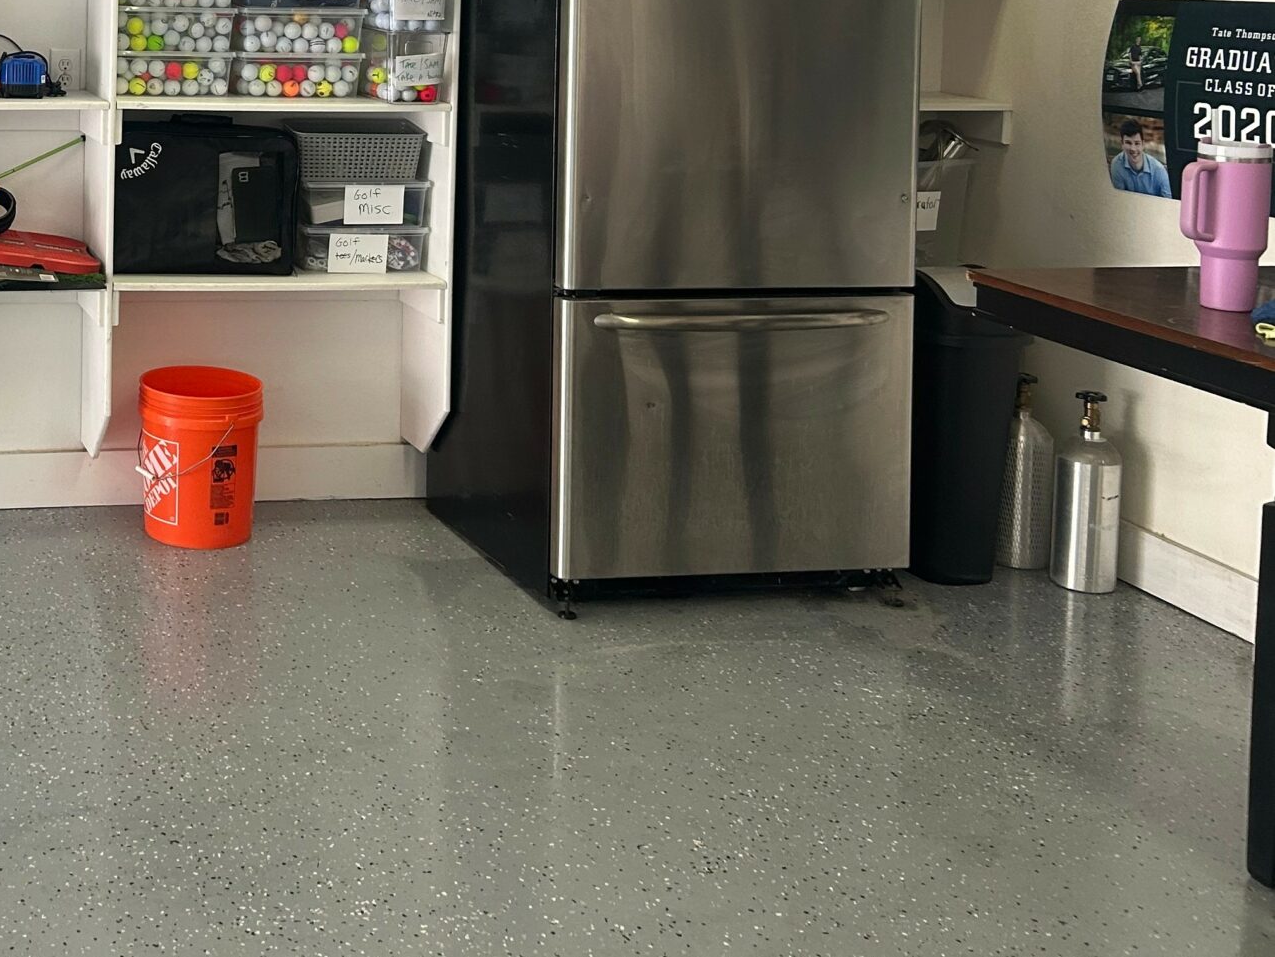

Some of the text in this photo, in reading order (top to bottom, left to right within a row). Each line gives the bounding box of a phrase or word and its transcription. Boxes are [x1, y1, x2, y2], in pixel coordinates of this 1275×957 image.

[1211, 27, 1232, 38] Tate
[1185, 45, 1275, 74] GRADUA
[1205, 78, 1275, 98] CLASS OF
[121, 142, 162, 180] Callaway
[354, 188, 381, 200] Golf
[335, 237, 360, 247] Golf
